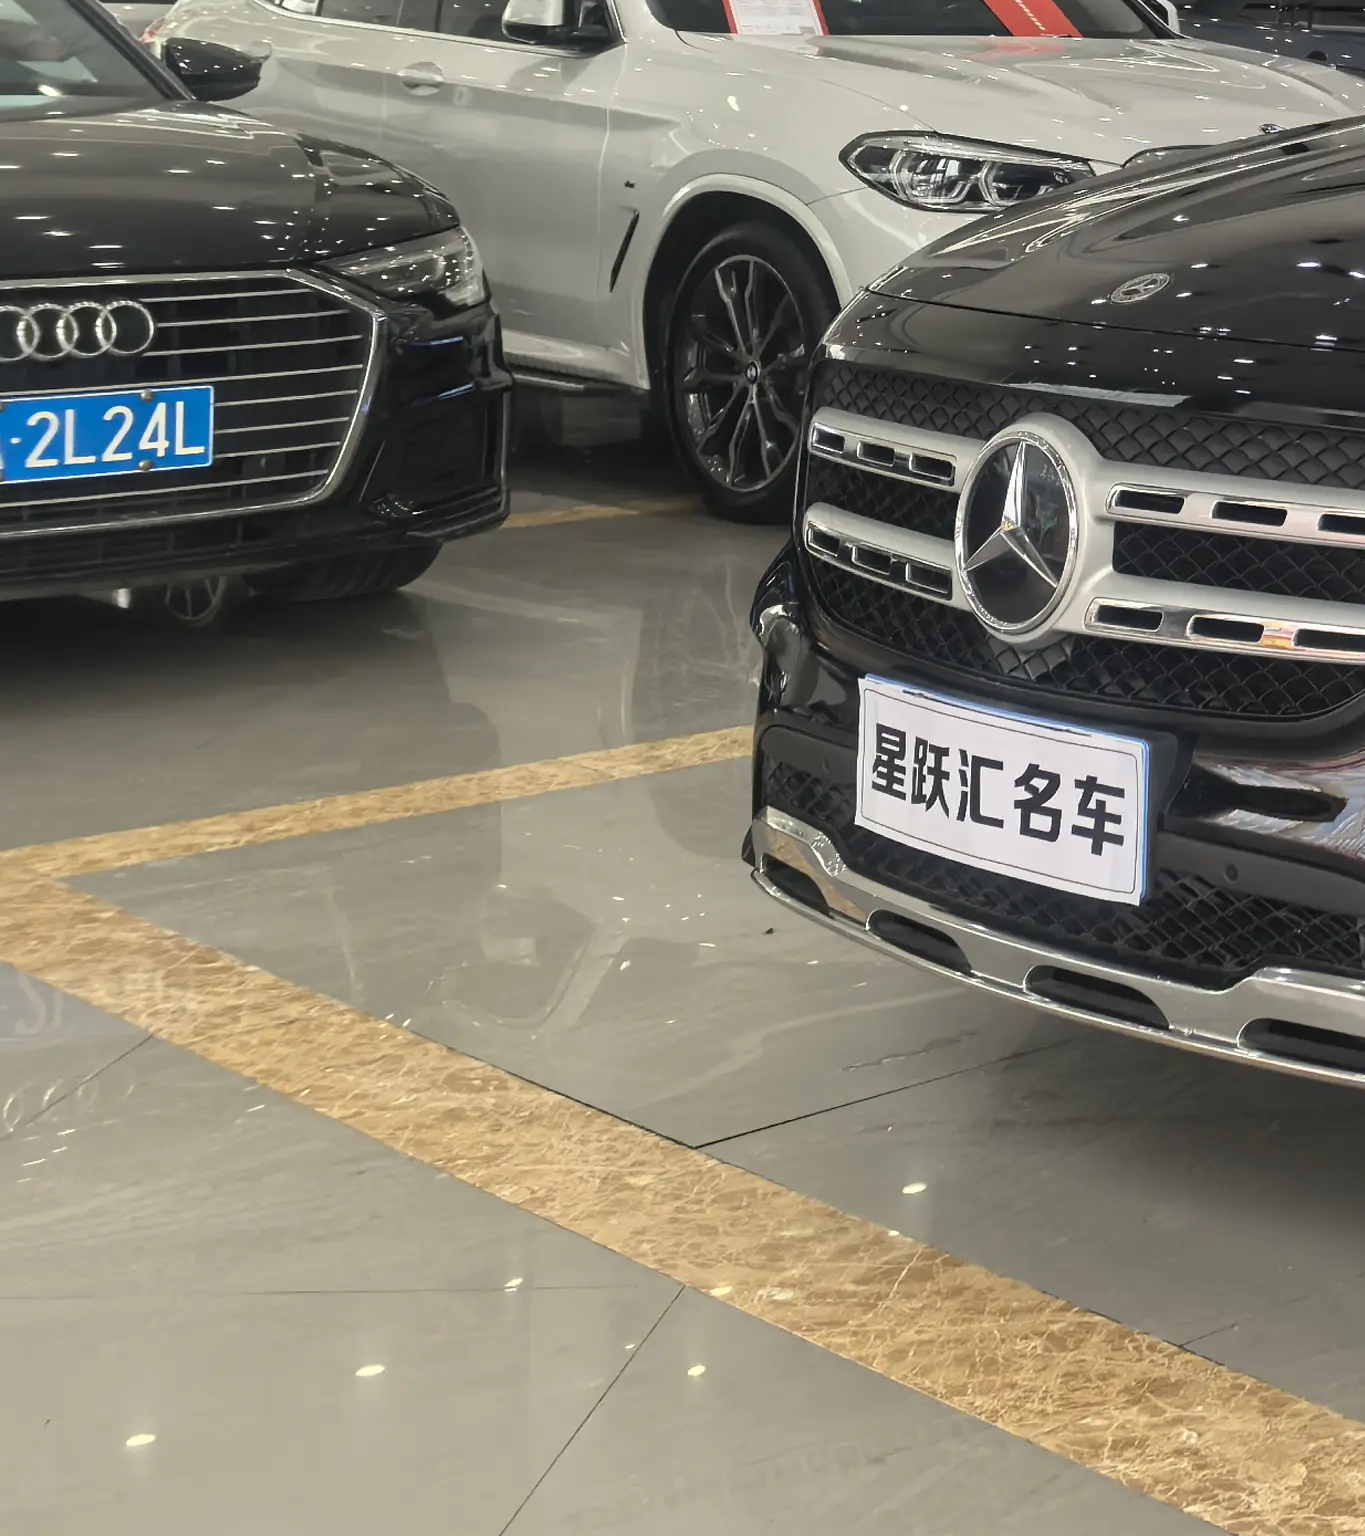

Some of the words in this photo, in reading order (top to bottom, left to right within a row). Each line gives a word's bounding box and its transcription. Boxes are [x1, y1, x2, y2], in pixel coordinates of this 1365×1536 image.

[871, 722, 1126, 857] 星跃汇名车
